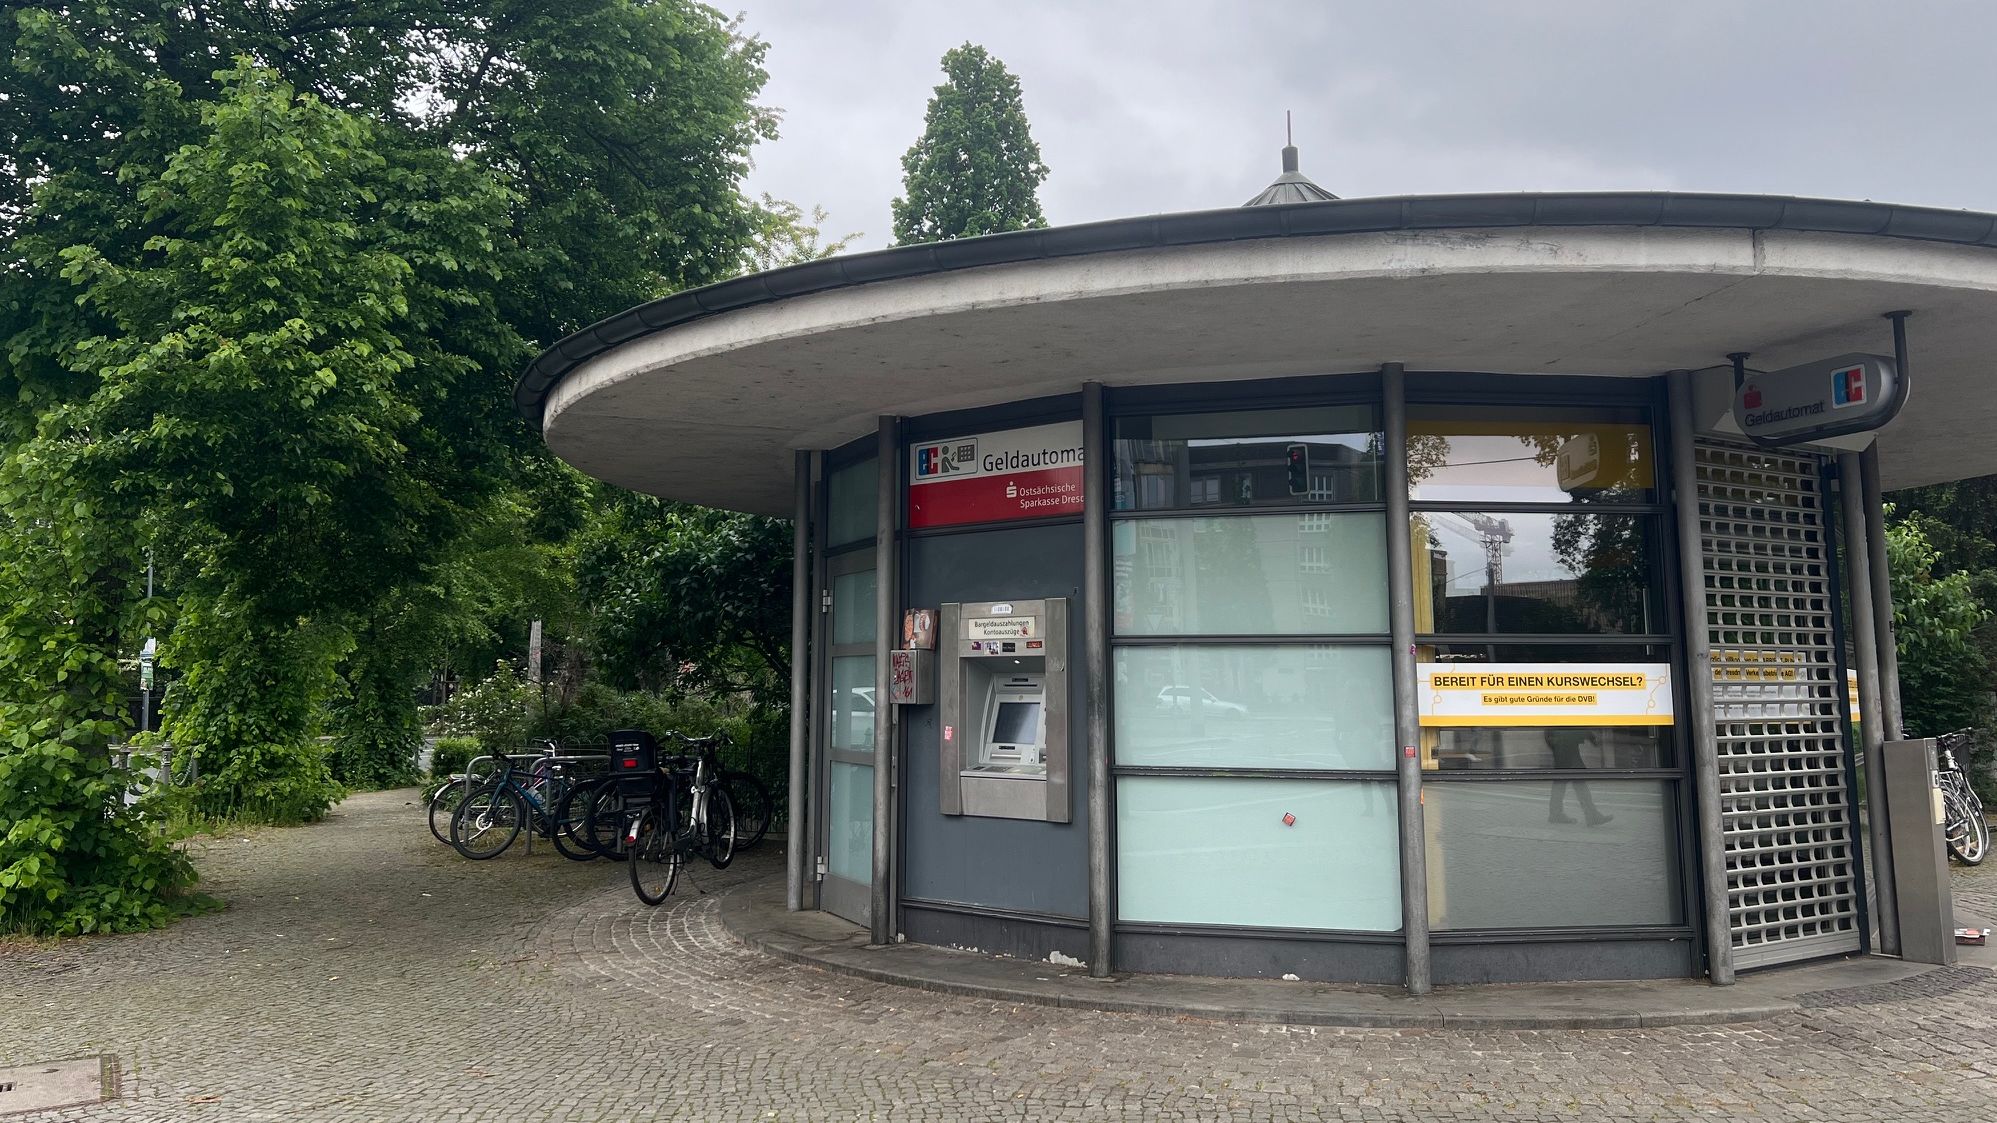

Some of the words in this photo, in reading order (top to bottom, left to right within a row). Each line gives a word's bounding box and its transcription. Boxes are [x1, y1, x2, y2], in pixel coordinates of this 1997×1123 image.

[1745, 402, 1824, 427] Geldautomat
[983, 446, 1083, 471] Geldautoma
[1020, 483, 1076, 497] Ostsächsische
[1020, 497, 1059, 509] Sparkasse
[974, 620, 1029, 628] Bargeldauszahlungen
[1434, 676, 1477, 687] BEREIT
[1481, 674, 1504, 687] FÜR
[1508, 676, 1543, 687] EINEN
[1547, 676, 1643, 687] KURSWECHSEL?
[1494, 695, 1507, 704] gibt
[1510, 696, 1525, 704] gute
[1527, 695, 1552, 703] Gründe
[1554, 695, 1564, 703] für
[1566, 695, 1576, 703] die
[1578, 695, 1595, 703] DVB!
